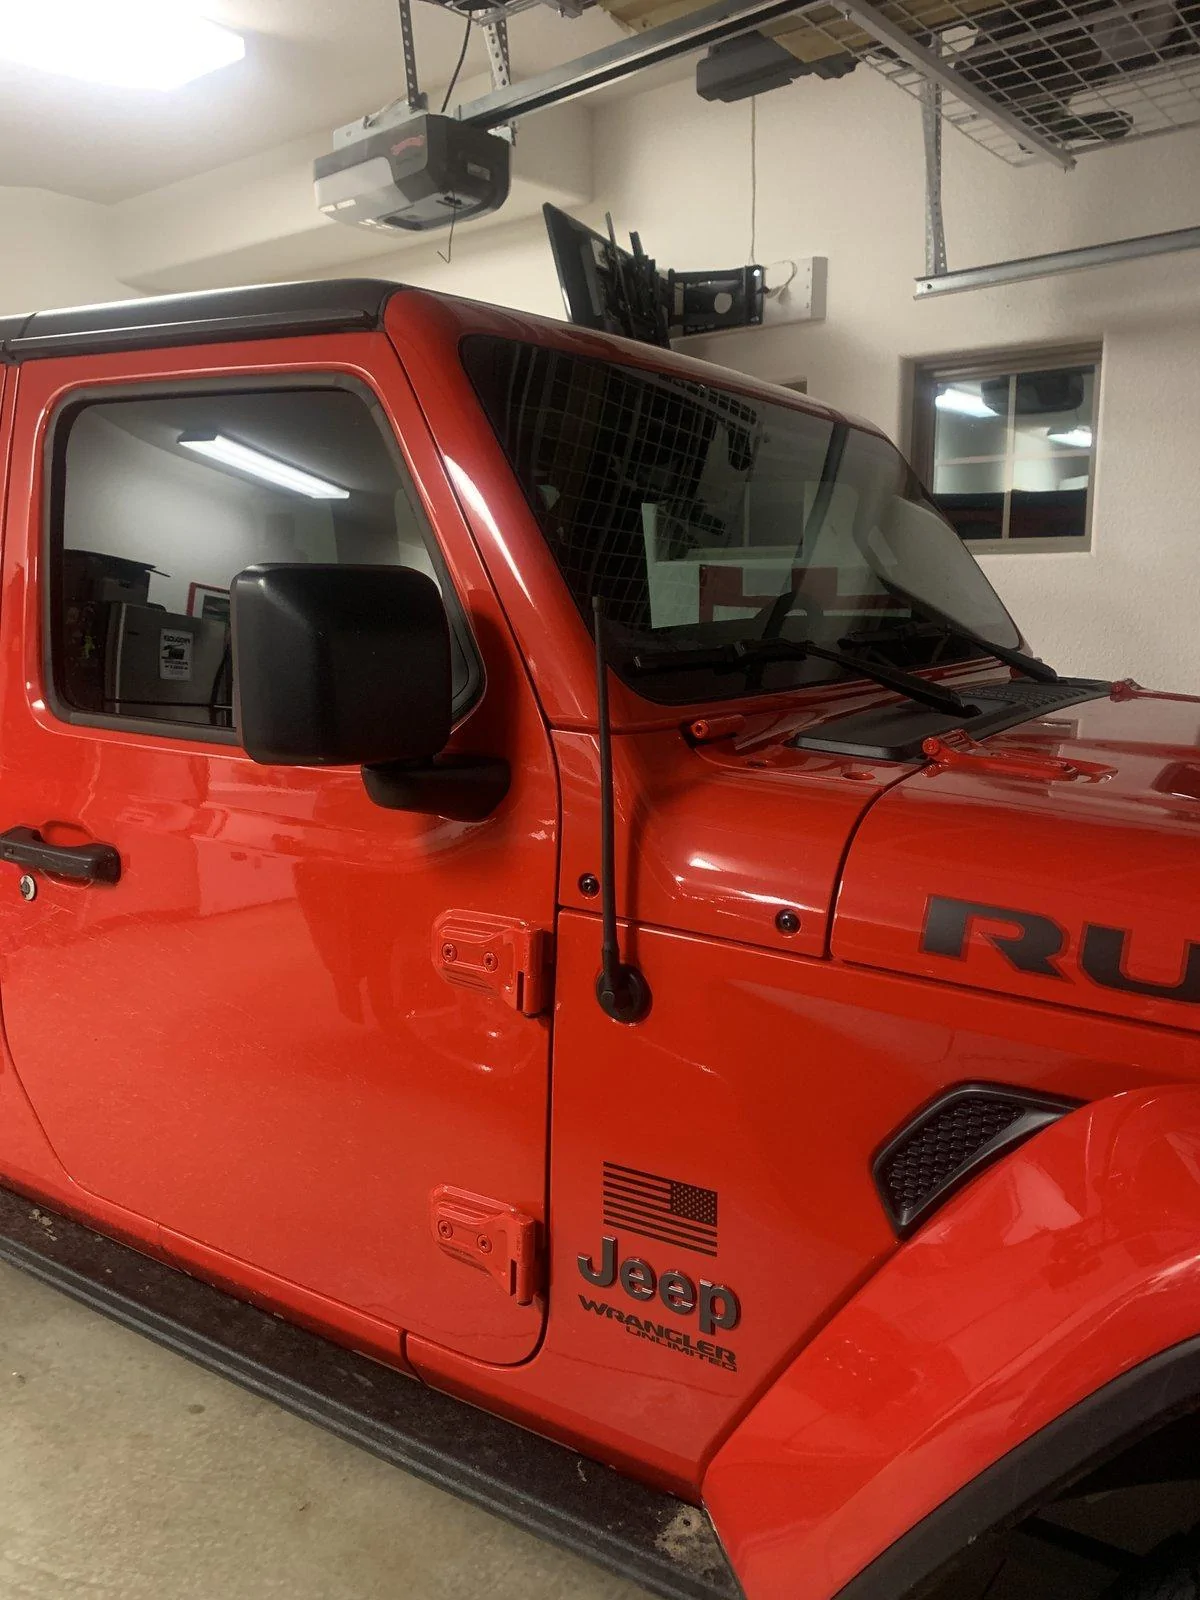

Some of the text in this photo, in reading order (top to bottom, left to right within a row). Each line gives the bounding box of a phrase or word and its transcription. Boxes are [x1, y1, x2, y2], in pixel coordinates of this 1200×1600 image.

[577, 1236, 741, 1335] Jeep
[578, 1294, 737, 1364] WRANGLER
[626, 1325, 738, 1373] UNLIMITED
